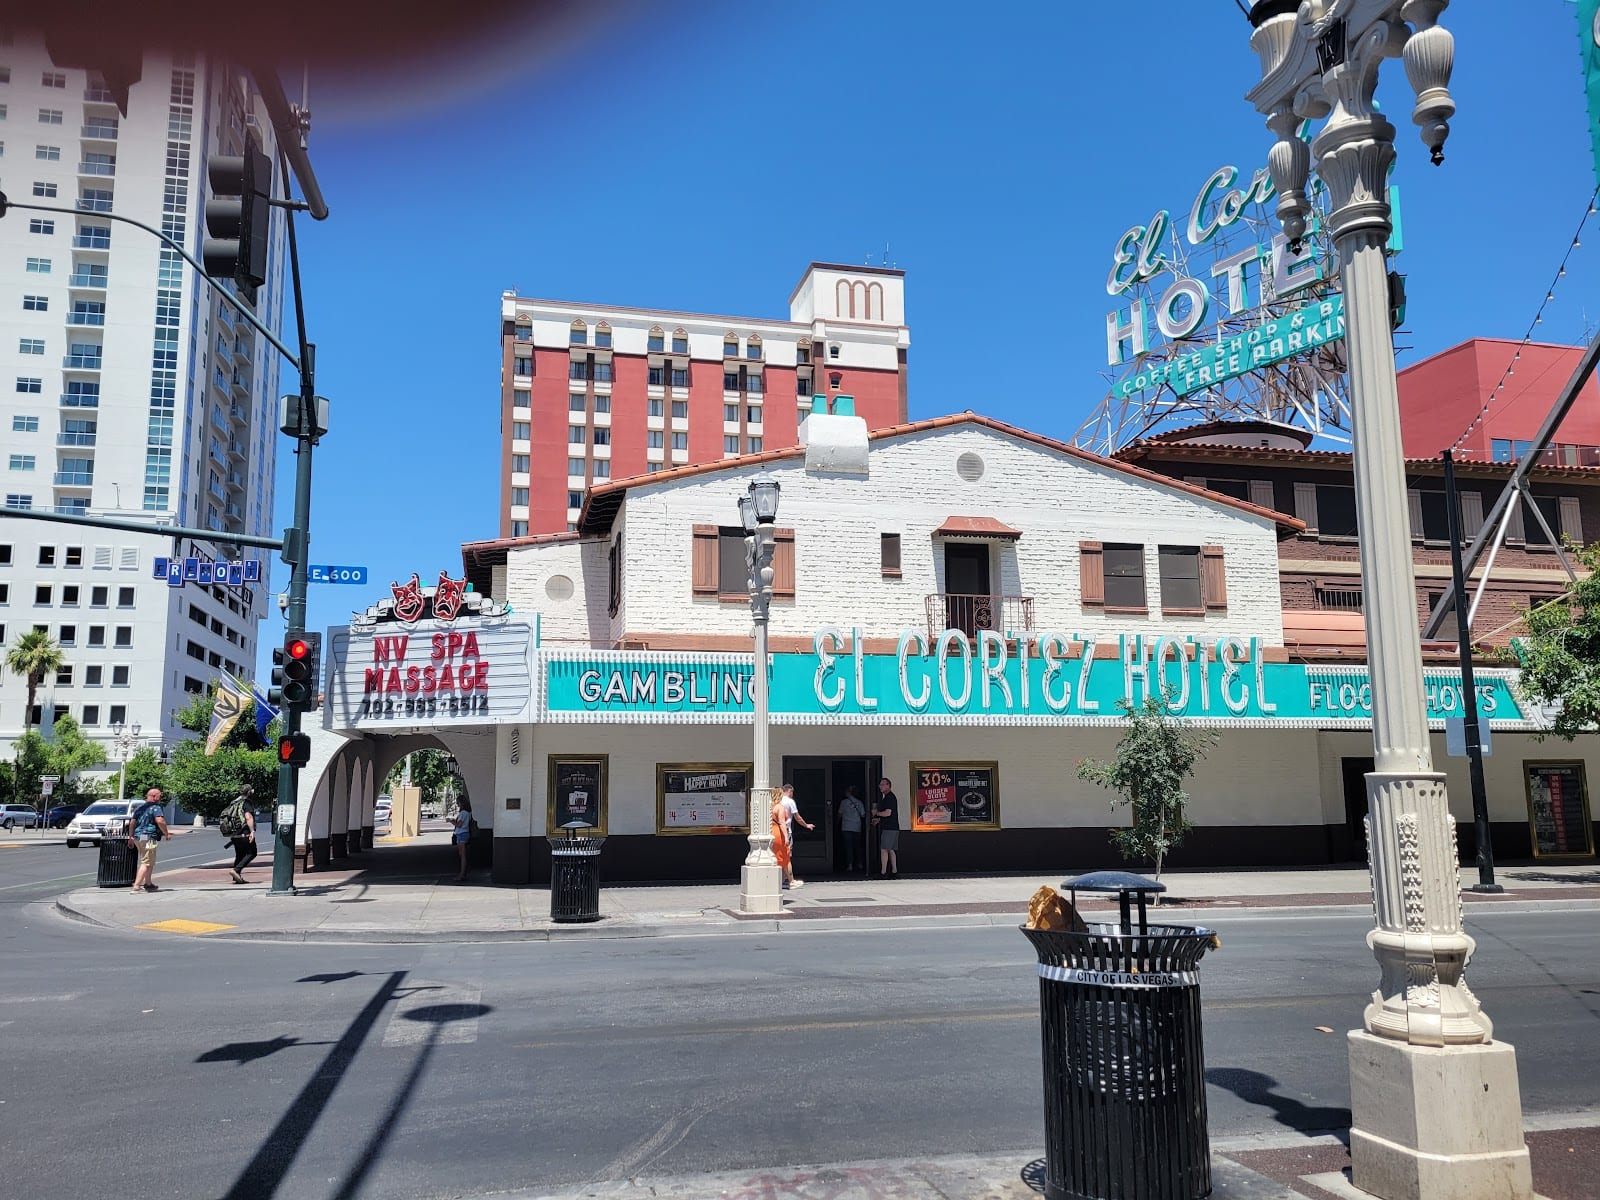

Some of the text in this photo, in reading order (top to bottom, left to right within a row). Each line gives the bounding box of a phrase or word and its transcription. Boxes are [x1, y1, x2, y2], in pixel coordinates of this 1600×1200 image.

[1106, 210, 1169, 295] El
[1106, 216, 1323, 366] HOTE
[1121, 354, 1202, 395] COFFEE
[1214, 323, 1278, 358] SHOP
[1290, 312, 1306, 330] &
[1185, 315, 1345, 390] FREE PARKIN
[330, 569, 361, 581] 600
[373, 631, 481, 663] NV SPA
[364, 661, 490, 695] MASSAGE
[813, 626, 1278, 712] EL CORTEZ HOTEL
[1308, 682, 1372, 711] FLOO
[684, 777, 708, 791] HAPPY
[708, 773, 728, 787] HOUR
[921, 772, 951, 787] 30%
[1077, 971, 1099, 983] CITY
[1101, 973, 1116, 985] OF
[1141, 974, 1174, 986] VEGAS
